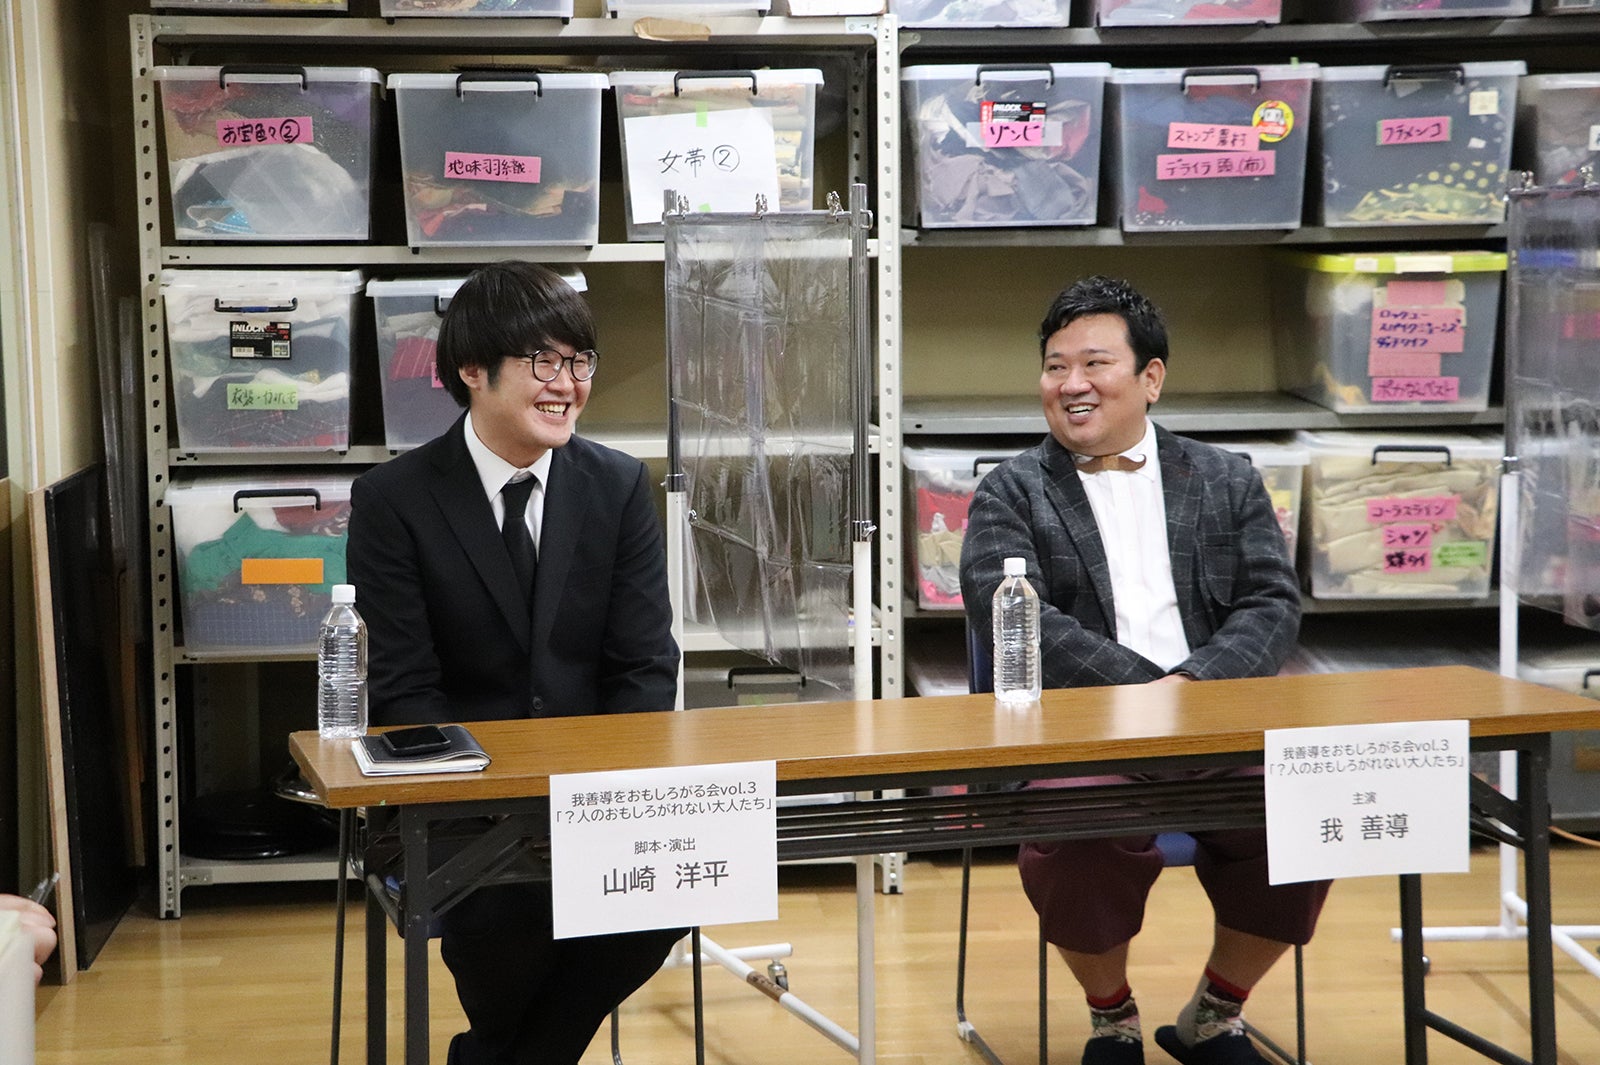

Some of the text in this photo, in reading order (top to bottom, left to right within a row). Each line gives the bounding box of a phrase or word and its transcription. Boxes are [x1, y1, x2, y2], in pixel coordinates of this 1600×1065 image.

[447, 158, 526, 176] 地味羽織
[657, 144, 741, 178] 女帯②
[1371, 503, 1447, 517] コーラスライン
[571, 780, 757, 808] 我善導をおもしろがる会vol.3
[1352, 791, 1377, 805] 主演
[1320, 813, 1409, 843] 我 善導
[633, 837, 696, 855] 脚本・演出
[603, 859, 729, 896] 山崎 洋平
